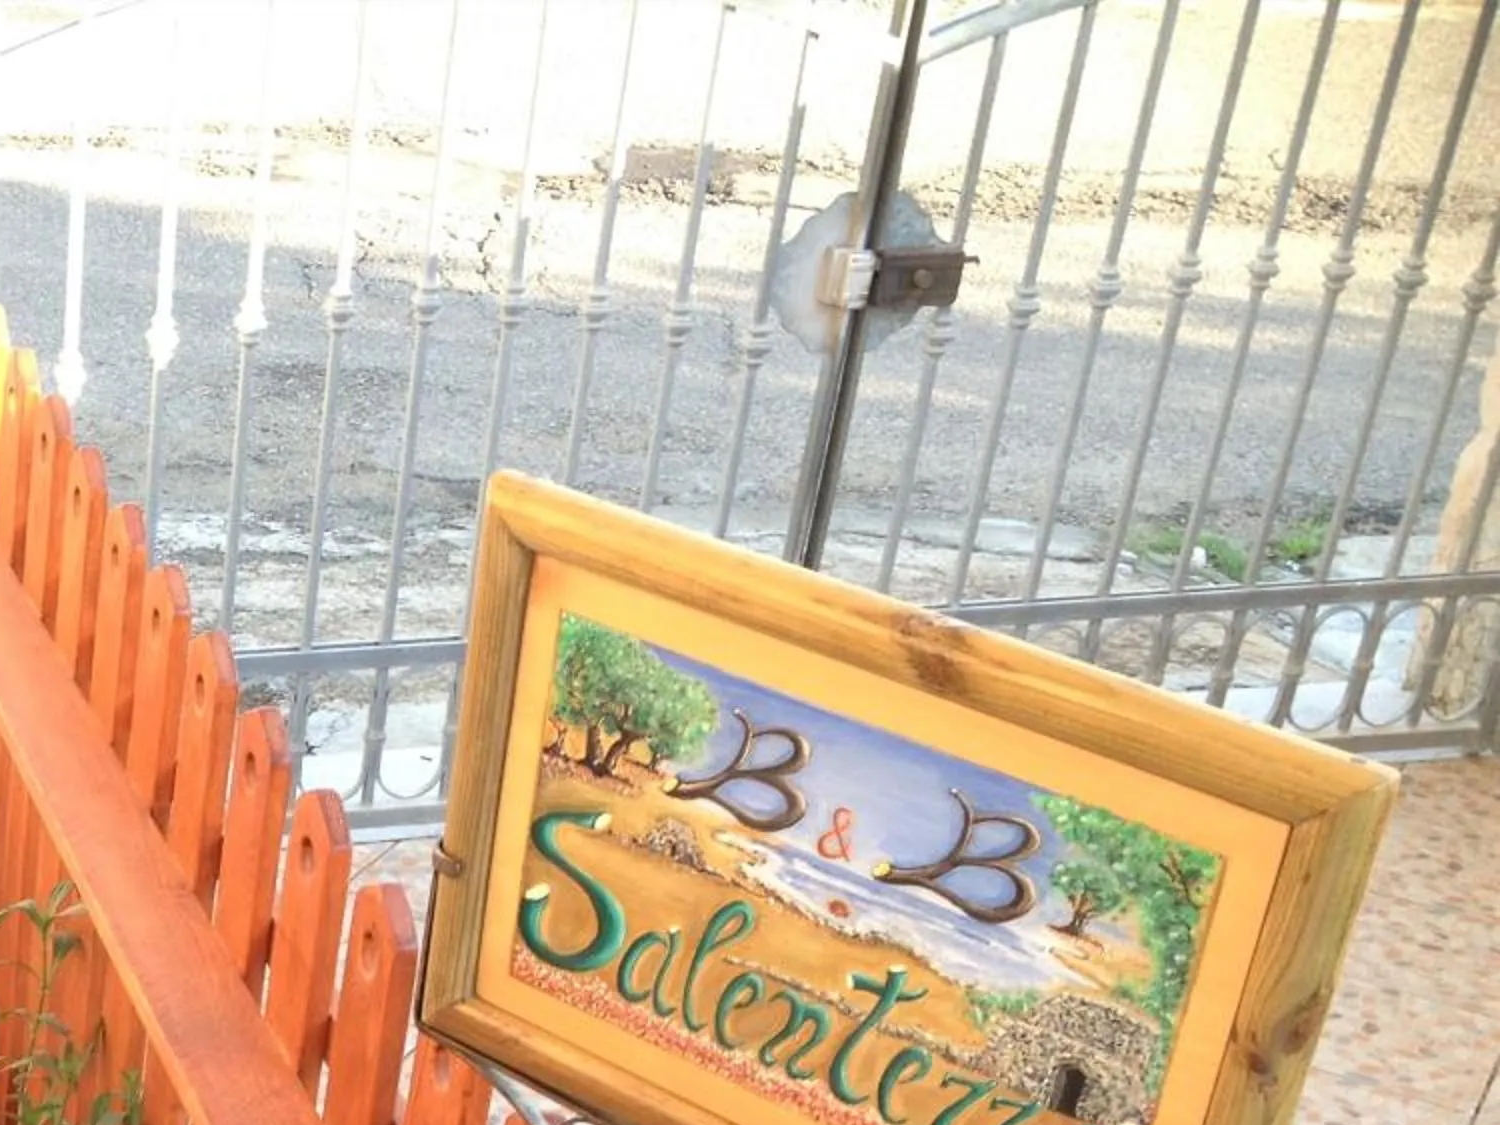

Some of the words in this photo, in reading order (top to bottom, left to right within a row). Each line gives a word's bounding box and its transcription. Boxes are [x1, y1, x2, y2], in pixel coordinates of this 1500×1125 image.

[665, 708, 810, 831] B
[818, 808, 853, 860] &
[872, 789, 1038, 922] B
